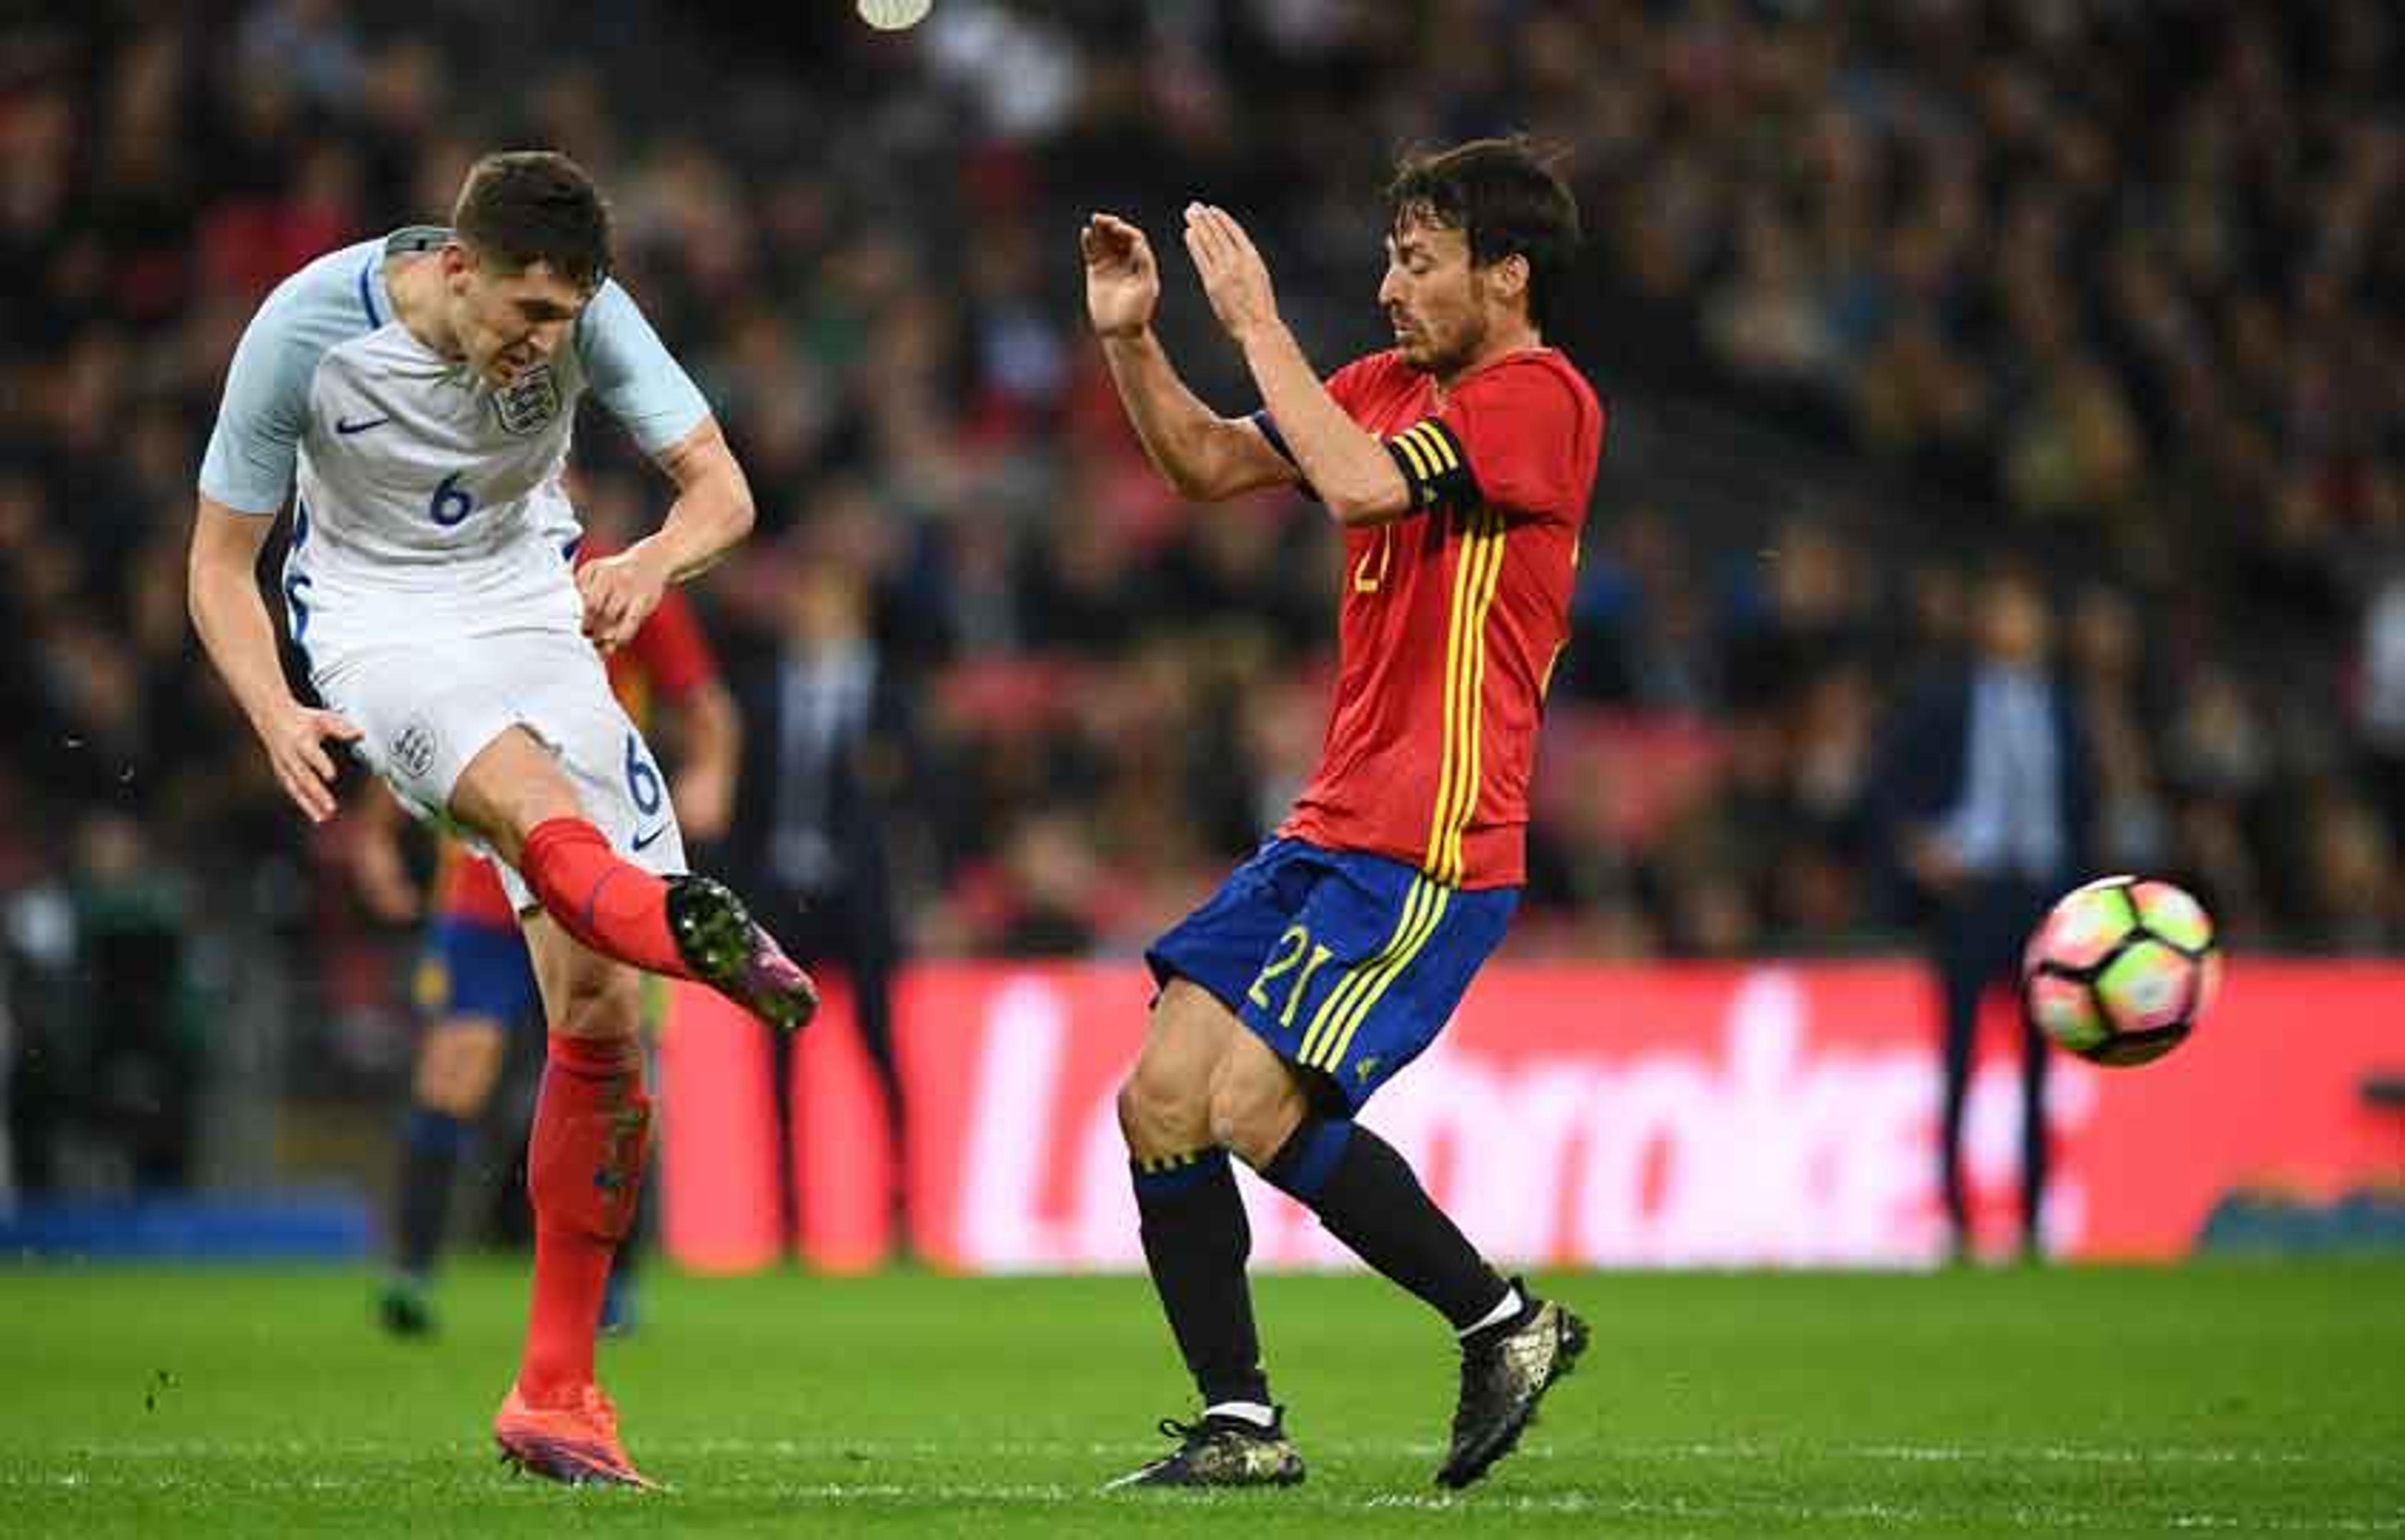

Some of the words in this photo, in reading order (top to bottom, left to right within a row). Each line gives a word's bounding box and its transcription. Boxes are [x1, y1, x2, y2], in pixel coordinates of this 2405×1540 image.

[430, 468, 472, 525] 6
[626, 731, 660, 816] 6
[1248, 924, 1334, 1028] 21
[955, 971, 2097, 1275] Lbrokes
